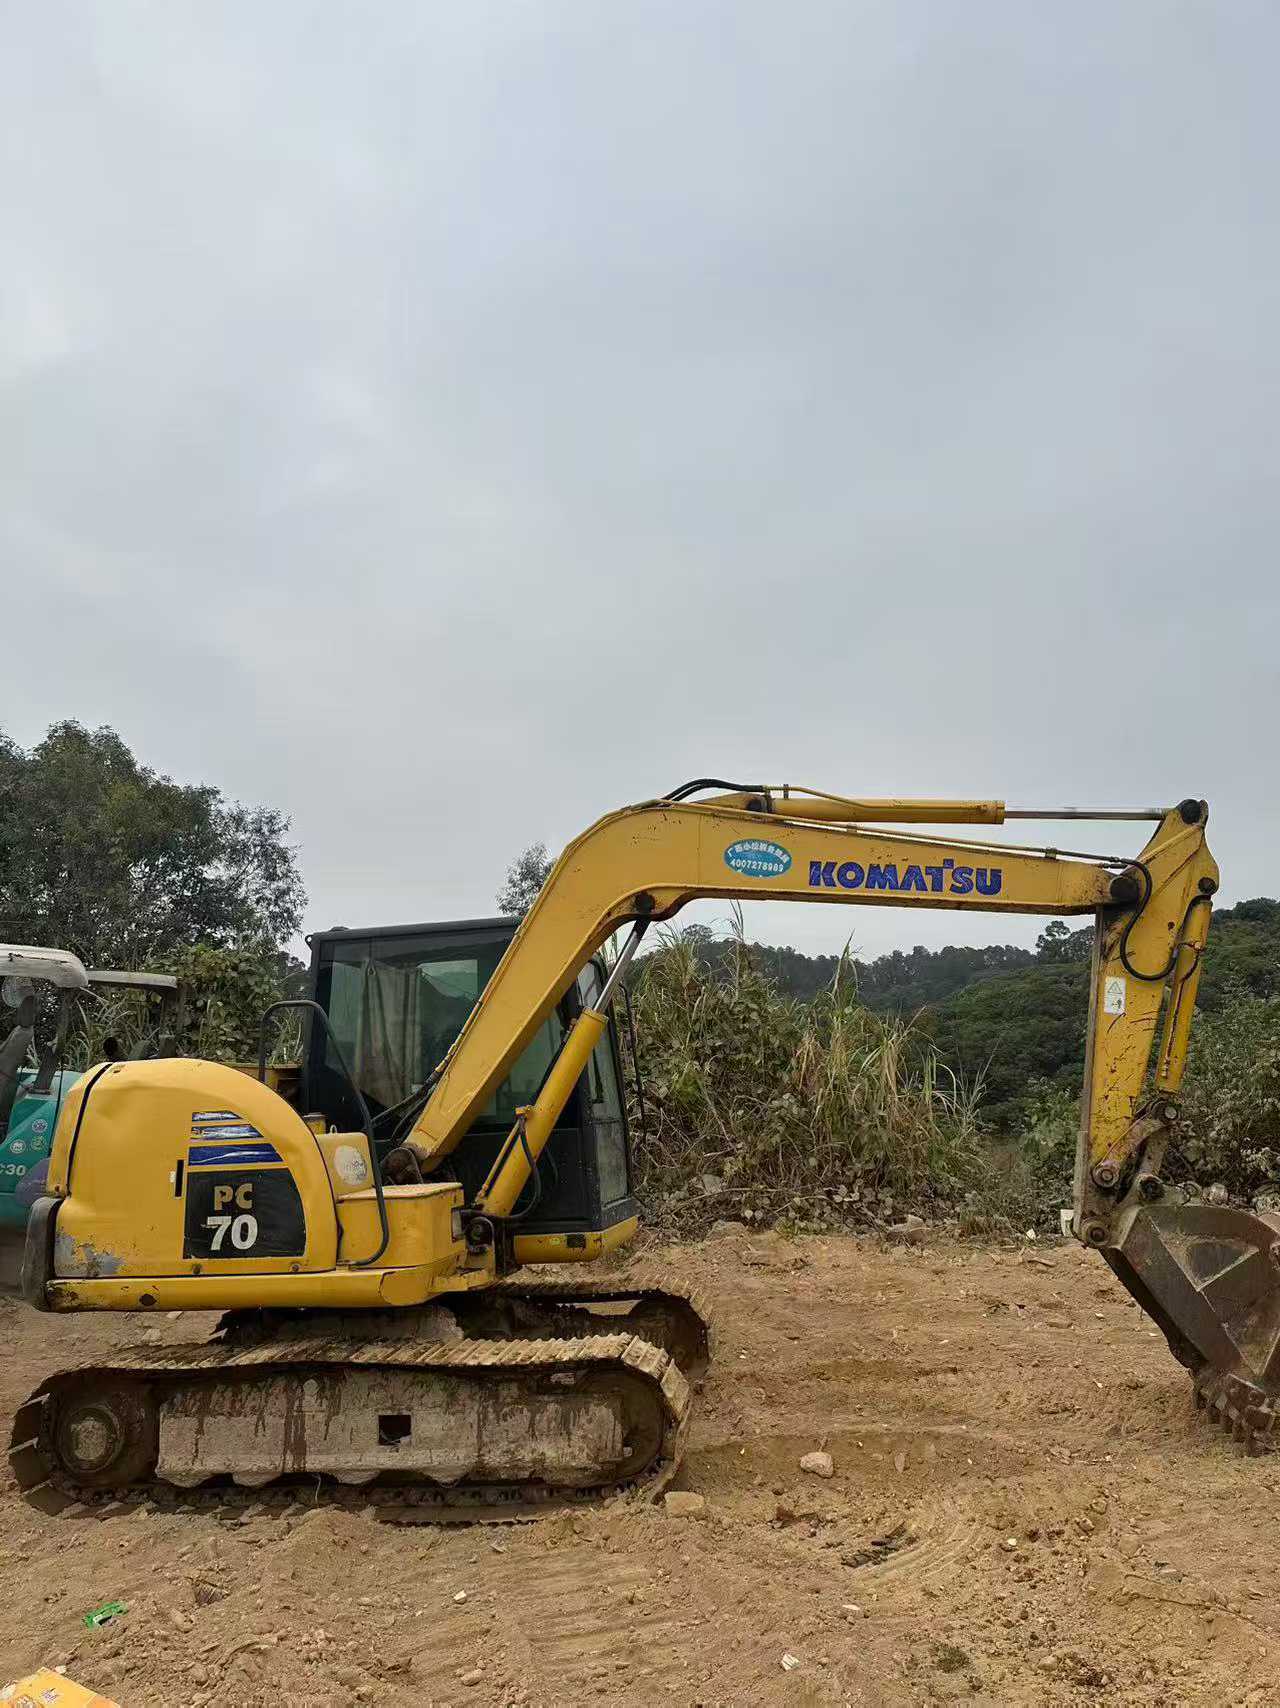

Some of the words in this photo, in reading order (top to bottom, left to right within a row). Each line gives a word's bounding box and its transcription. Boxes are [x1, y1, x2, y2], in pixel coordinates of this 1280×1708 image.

[809, 859, 1002, 896] KOMATSU
[214, 1183, 253, 1211] PC
[207, 1214, 258, 1250] 70
